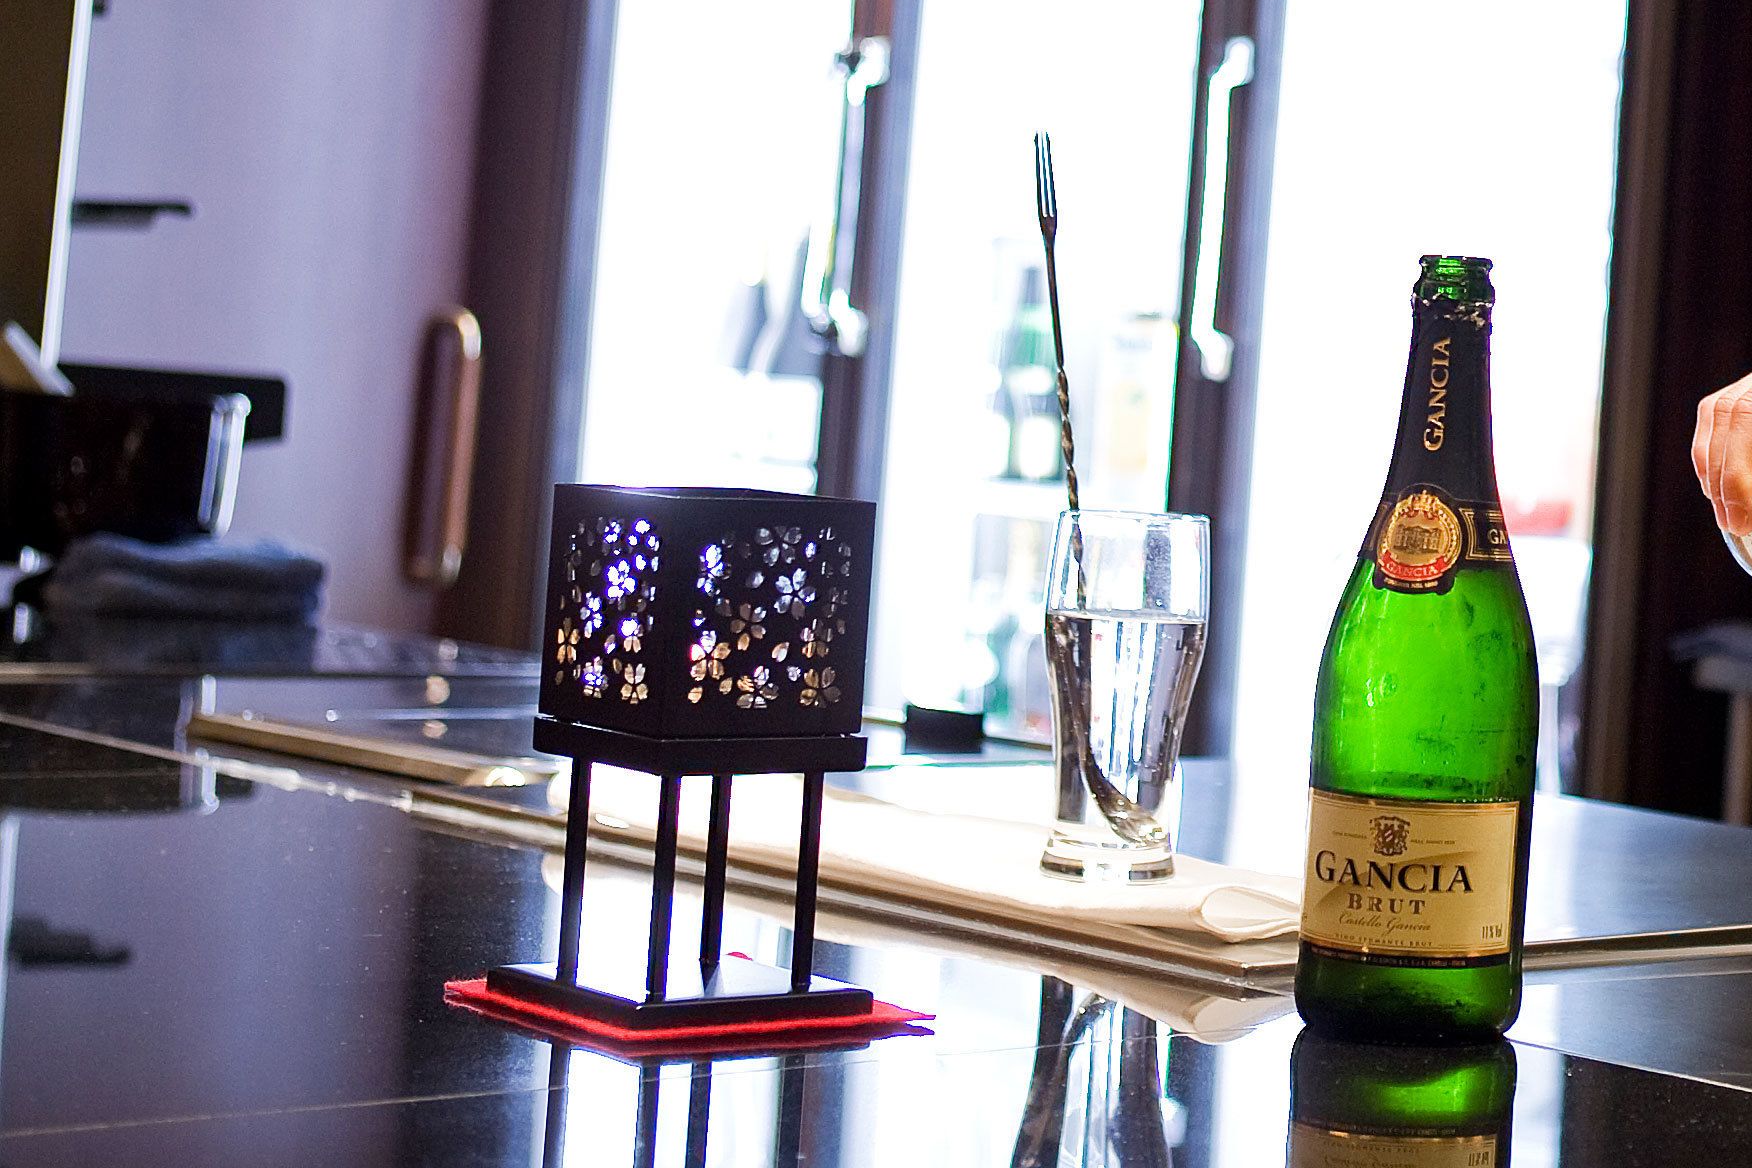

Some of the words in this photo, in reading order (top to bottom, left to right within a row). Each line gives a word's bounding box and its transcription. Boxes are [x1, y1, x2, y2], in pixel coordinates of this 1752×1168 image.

[1423, 337, 1451, 452] GANCIA
[1386, 561, 1438, 577] GANCIA
[1314, 849, 1474, 893] GANCIA
[1347, 892, 1426, 915] BRUT
